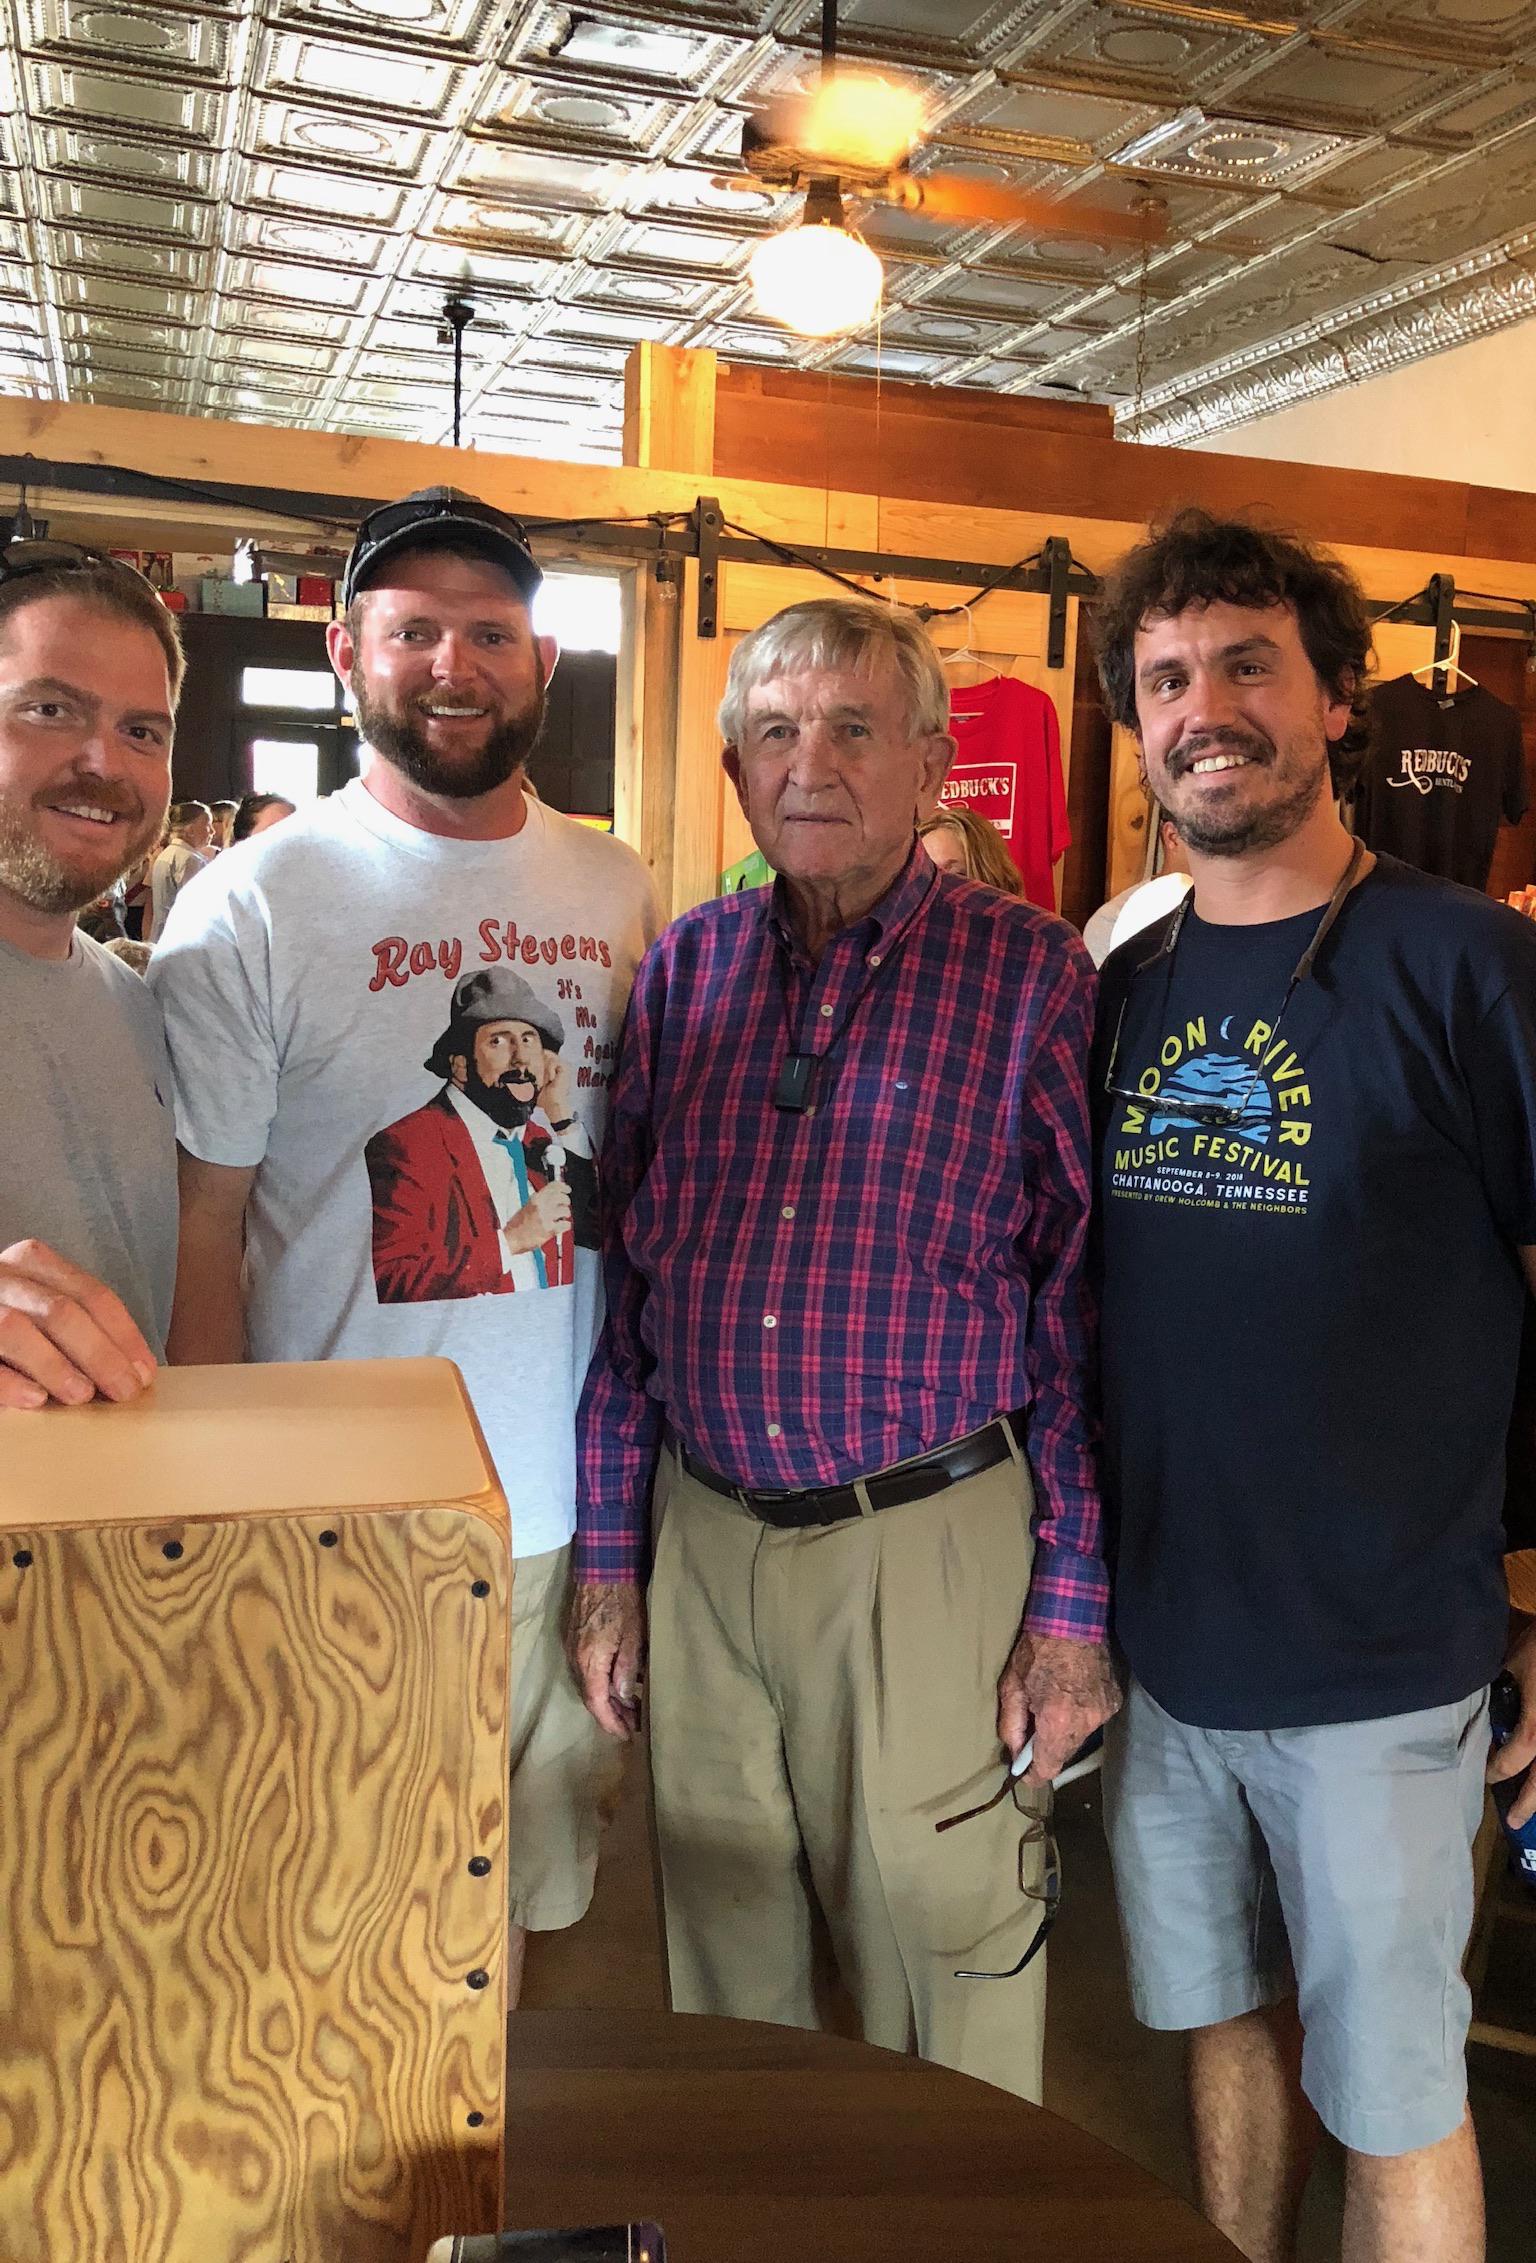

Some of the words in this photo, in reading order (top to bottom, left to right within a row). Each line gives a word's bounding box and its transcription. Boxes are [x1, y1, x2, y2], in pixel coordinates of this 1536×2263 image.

[941, 777, 1010, 800] EDBUCK'S
[368, 936, 462, 992] Ray
[478, 918, 612, 968] Stevens
[557, 979, 582, 1000] It's
[575, 1006, 597, 1029] Me
[584, 1035, 618, 1065] Agai
[1121, 1016, 1207, 1135] MOON
[1243, 1019, 1312, 1146] RIVER
[1114, 1137, 1180, 1171] MUSIC
[1193, 1134, 1311, 1186] FESTIVAL
[1156, 1166, 1204, 1179] SEPTEMBER
[1225, 1173, 1243, 1181] 2018
[1111, 1189, 1143, 1201] PRESENTED
[1144, 1193, 1153, 1201] BY
[1155, 1194, 1176, 1204] DREW
[1178, 1197, 1221, 1209] HOLCOMB
[1223, 1201, 1229, 1209] &
[1232, 1201, 1247, 1210] THE
[1250, 1202, 1308, 1215] NEIGHBORS
[1112, 1173, 1208, 1197] CHATTANOOGA,
[1216, 1184, 1309, 1203] TENNESSEE
